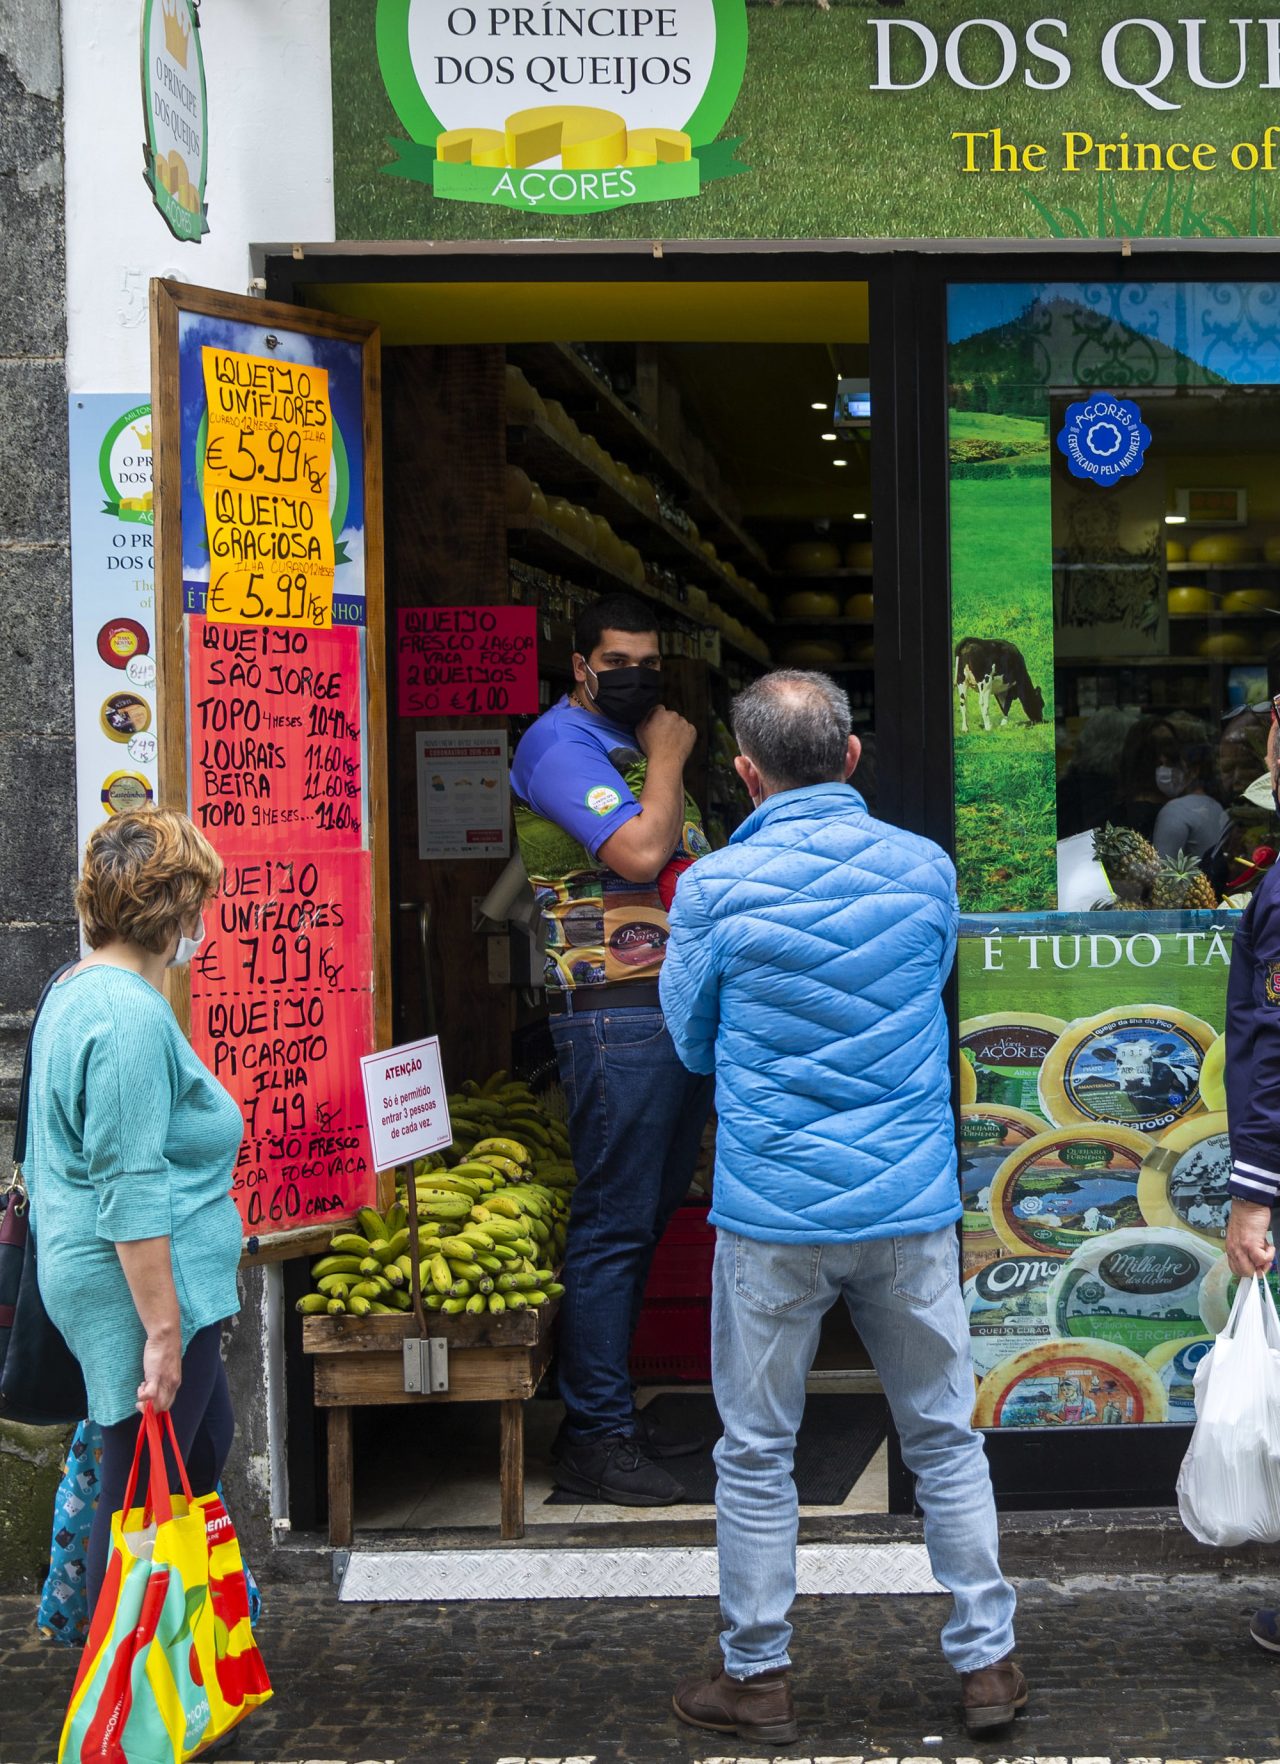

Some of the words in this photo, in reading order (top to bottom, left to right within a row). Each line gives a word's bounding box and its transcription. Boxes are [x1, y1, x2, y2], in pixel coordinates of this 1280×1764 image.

[448, 7, 476, 37] O
[487, 1, 679, 37] PRÍNCIPE
[867, 18, 1071, 90] DOS
[156, 56, 162, 80] O
[164, 61, 197, 118] PRÍNCIPE
[434, 56, 515, 87] DOS
[525, 55, 692, 96] QUEIJOS
[154, 92, 170, 127] DOS
[170, 107, 199, 156] QUEIJOS
[952, 128, 1047, 172] The
[1061, 131, 1218, 172] Prince
[1230, 126, 1280, 171] of
[491, 169, 637, 206] AÇORES
[165, 196, 192, 234] AÇORES
[215, 355, 311, 398] QUEIJO
[124, 405, 152, 423] MILTON
[220, 390, 327, 427] UNIFLORES
[1075, 402, 1133, 429] AÇORES
[302, 429, 326, 443] ILHA
[123, 457, 133, 467] O
[206, 437, 228, 470] €
[229, 430, 301, 482] 5.99
[1067, 433, 1099, 474] CERTIFICADO
[1100, 463, 1121, 475] PELA
[1119, 429, 1141, 469] NATUREZA
[119, 473, 147, 485] DOS
[215, 489, 313, 530] QUEIJO
[112, 534, 126, 548] O
[212, 527, 321, 560] GRACIOSA
[107, 556, 144, 570] DOS
[235, 561, 264, 573] ILHA
[140, 596, 152, 609] of
[210, 572, 232, 612] €
[240, 573, 307, 618] 5.99
[405, 611, 497, 634] QUEIJO
[203, 625, 308, 655] QUEIJO
[400, 635, 474, 654] FRESCO
[478, 636, 534, 651] LAGOA
[423, 652, 463, 665] VACA
[480, 651, 526, 665] FOGO
[207, 653, 262, 689] SÃO
[265, 665, 342, 699] JORGE
[406, 665, 420, 686] 2
[424, 665, 517, 687] QUEIJOS
[407, 688, 440, 711] SÓ
[197, 697, 261, 732] TOPO
[272, 713, 303, 728] MESES
[200, 738, 287, 770] LOURAIS
[304, 744, 342, 772] 11.60
[205, 771, 270, 799] BEIRA
[303, 771, 343, 800] 11.60
[197, 801, 245, 828] TOPO
[222, 860, 319, 898] UEIJO
[221, 900, 344, 933] UNIFLORES
[617, 929, 660, 945] Beira
[983, 928, 1003, 971] É
[1018, 932, 1162, 971] TUDO
[1177, 924, 1232, 967] TÃ
[195, 941, 226, 981] €
[239, 934, 311, 985] 7.99
[208, 996, 324, 1038] QUEIJO
[1095, 1022, 1117, 1036] queijo
[1156, 1019, 1173, 1030] Pico
[214, 1035, 328, 1076] PICAROTO
[979, 1046, 1046, 1060] AÇORES
[252, 1067, 308, 1093] ILHA
[384, 1058, 422, 1081] ATENÇÃO
[383, 1097, 393, 1109] Só
[394, 1095, 399, 1107] é
[400, 1086, 431, 1107] permitido
[244, 1093, 306, 1137] 7.49
[381, 1110, 402, 1126] entrar
[403, 1107, 409, 1119] 3
[409, 1100, 437, 1120] pessoas
[391, 1126, 400, 1140] de
[401, 1122, 418, 1137] cada
[418, 1118, 433, 1131] vez.
[308, 1138, 360, 1160] FRESCO
[1066, 1147, 1108, 1155] QUEIJARIA
[282, 1162, 325, 1183] FOGO
[328, 1156, 367, 1178] VACA
[247, 1184, 300, 1225] 0.60
[305, 1195, 345, 1215] CADA
[1109, 1253, 1191, 1277] Milhafre
[1142, 1273, 1173, 1286] Açores
[979, 1327, 1014, 1335] QUEIJO
[1128, 1330, 1194, 1339] TERCEIRA
